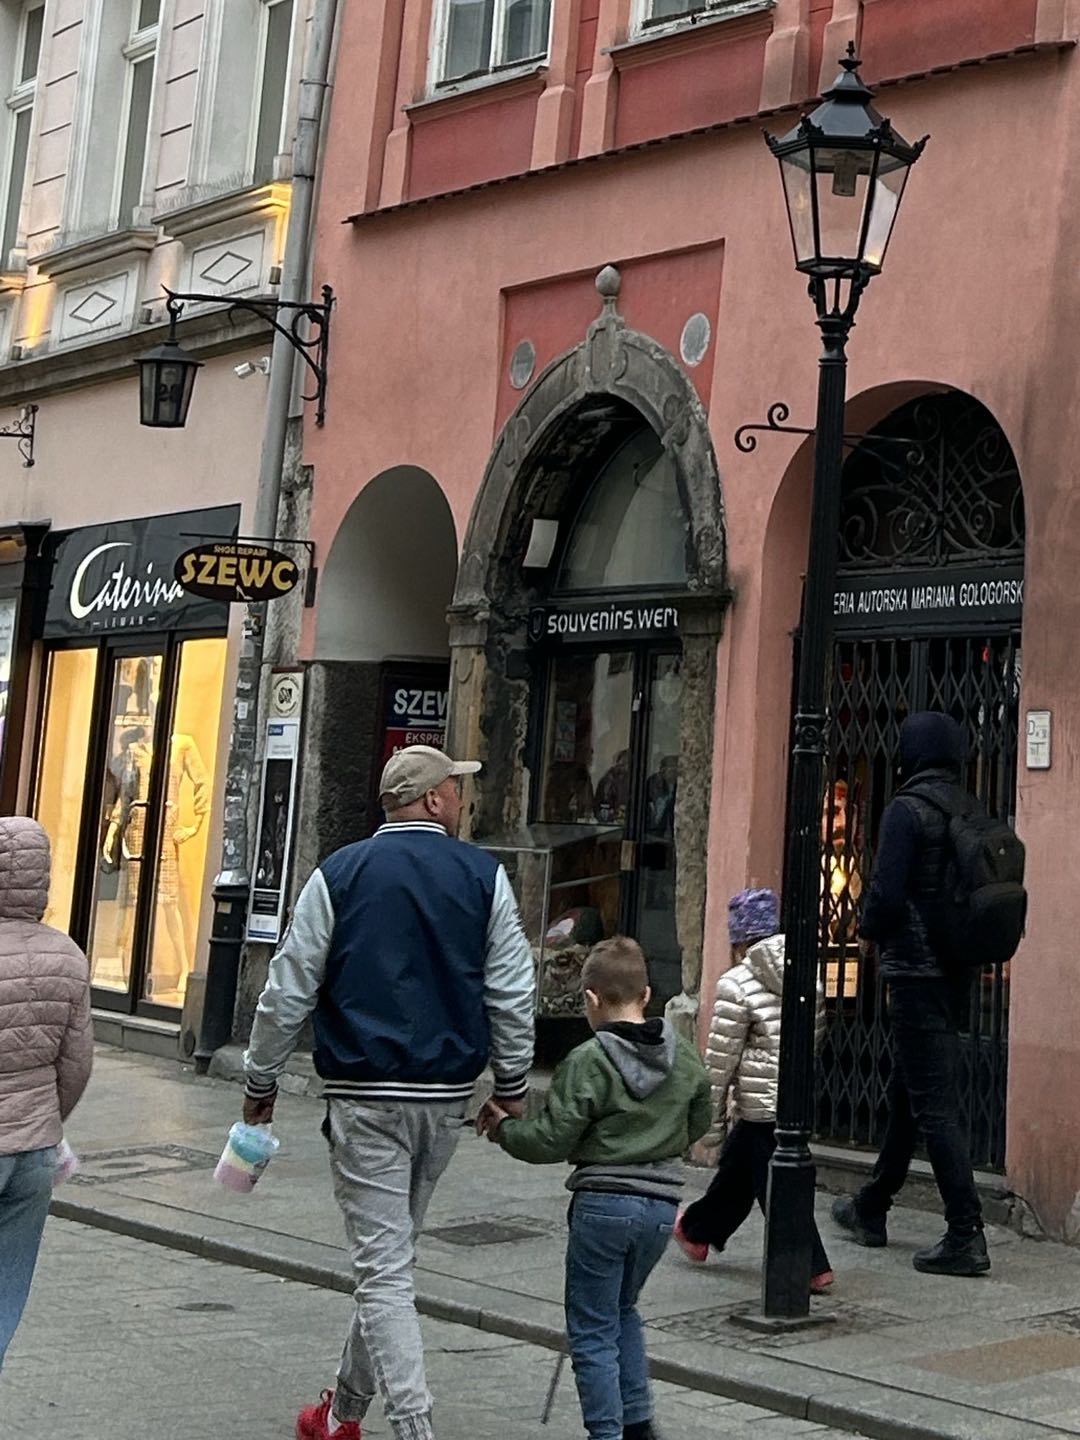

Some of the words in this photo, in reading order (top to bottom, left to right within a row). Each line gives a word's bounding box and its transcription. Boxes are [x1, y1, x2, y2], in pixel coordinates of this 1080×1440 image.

[214, 544, 236, 555] SHOE
[237, 546, 268, 558] REPAIR
[70, 542, 184, 619] Caterina
[181, 553, 294, 591] SZEWC
[857, 588, 908, 613] AUTORSKA
[911, 584, 955, 610] MARIANA
